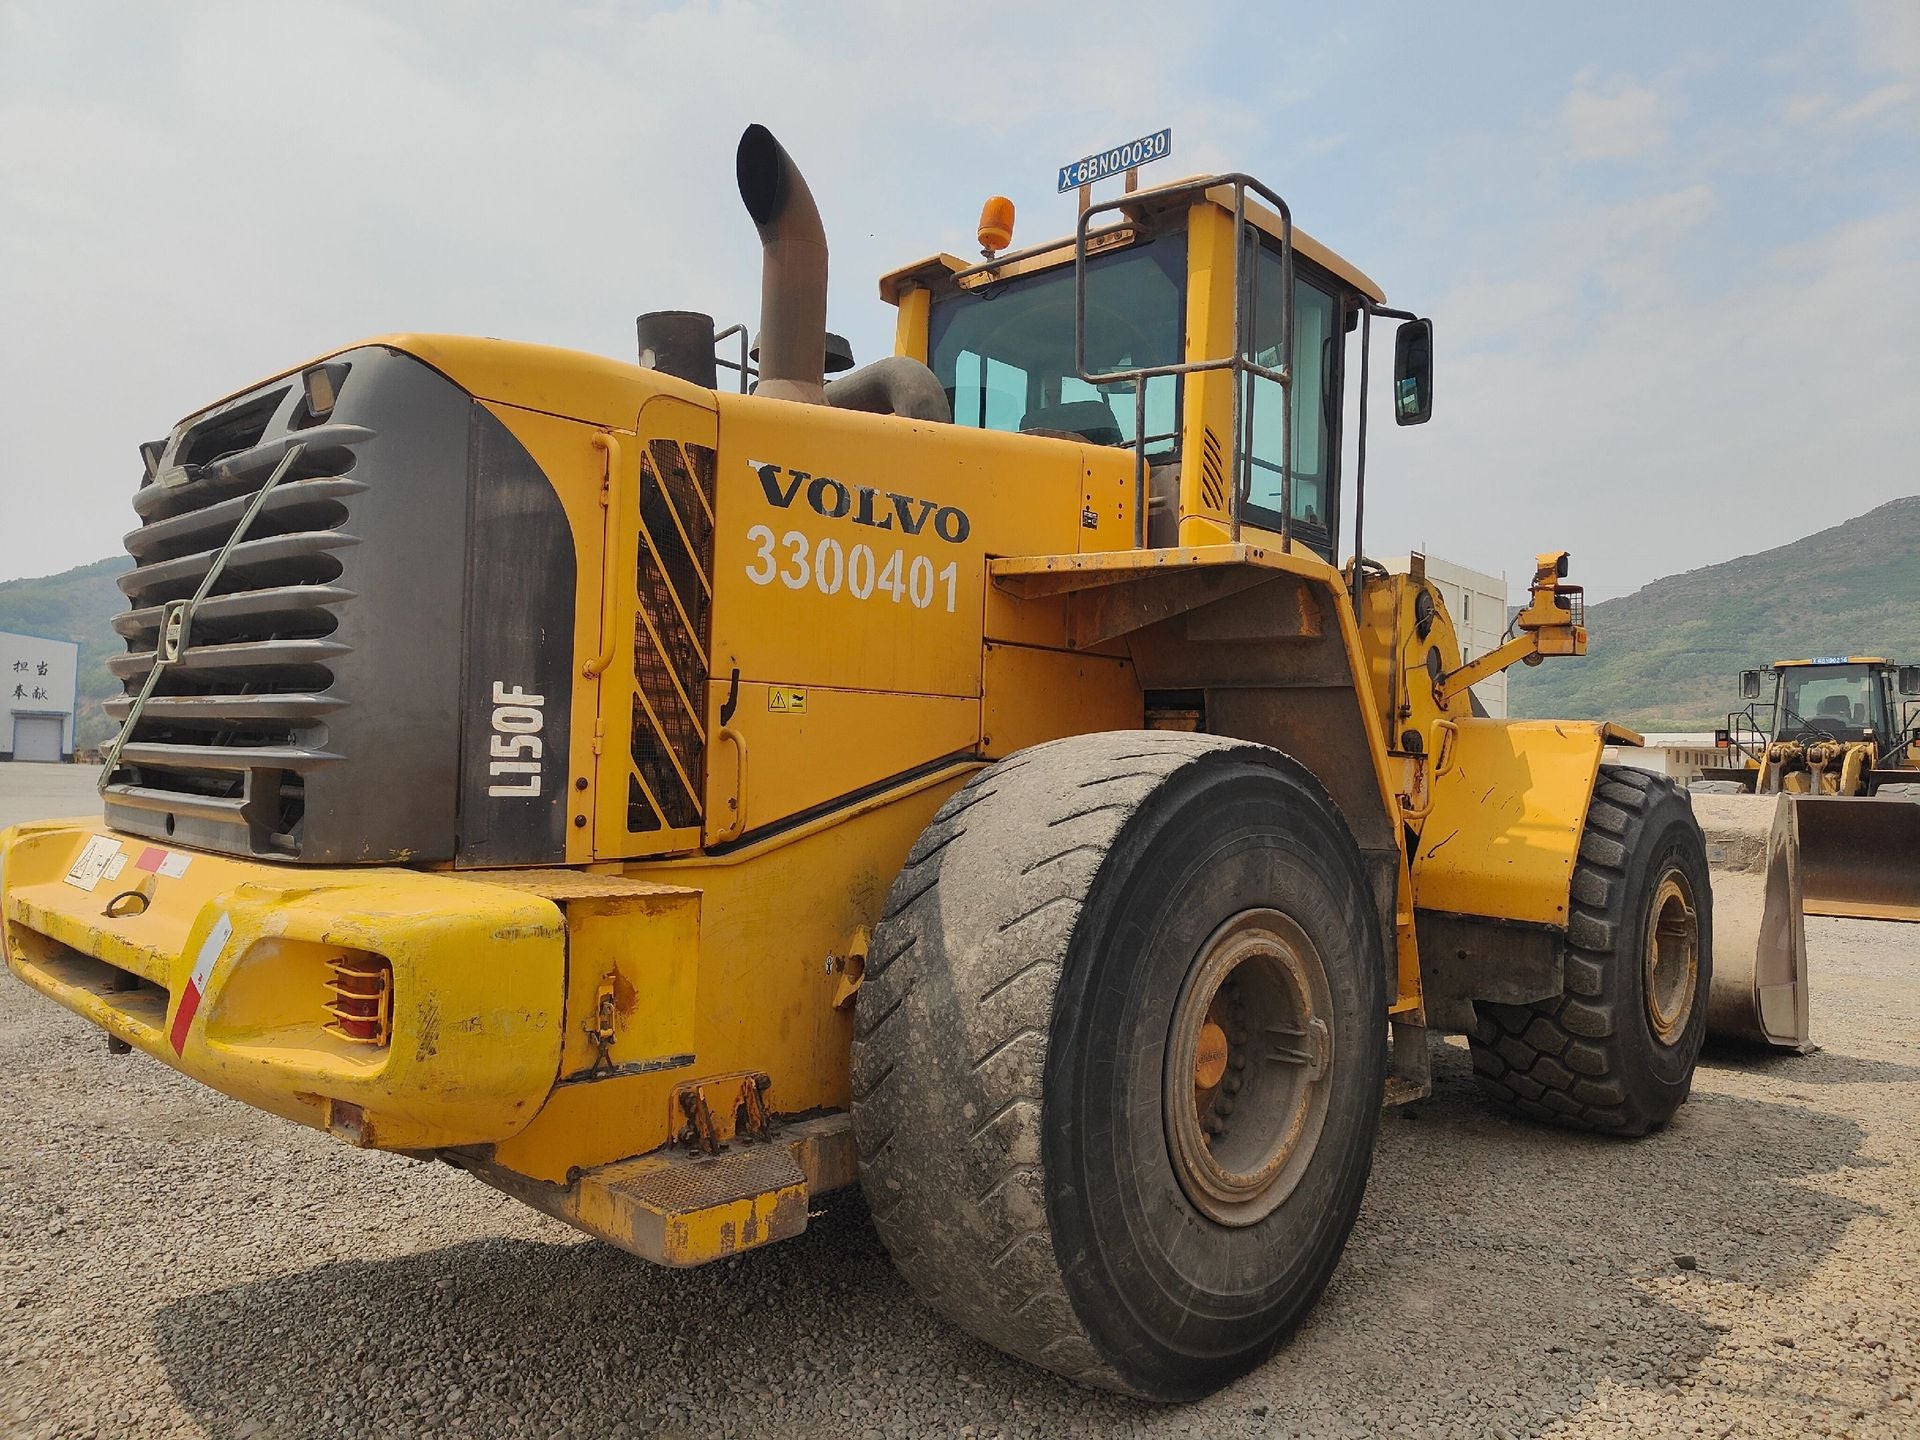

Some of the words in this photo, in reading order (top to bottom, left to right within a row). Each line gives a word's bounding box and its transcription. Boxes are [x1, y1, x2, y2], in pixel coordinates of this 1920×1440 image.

[1062, 132, 1165, 188] X-6BN00030
[747, 460, 970, 543] VOLVO
[745, 525, 957, 613] 3300401
[12, 683, 49, 700] 奉献
[13, 660, 49, 676] 担当
[488, 681, 545, 797] L150F
